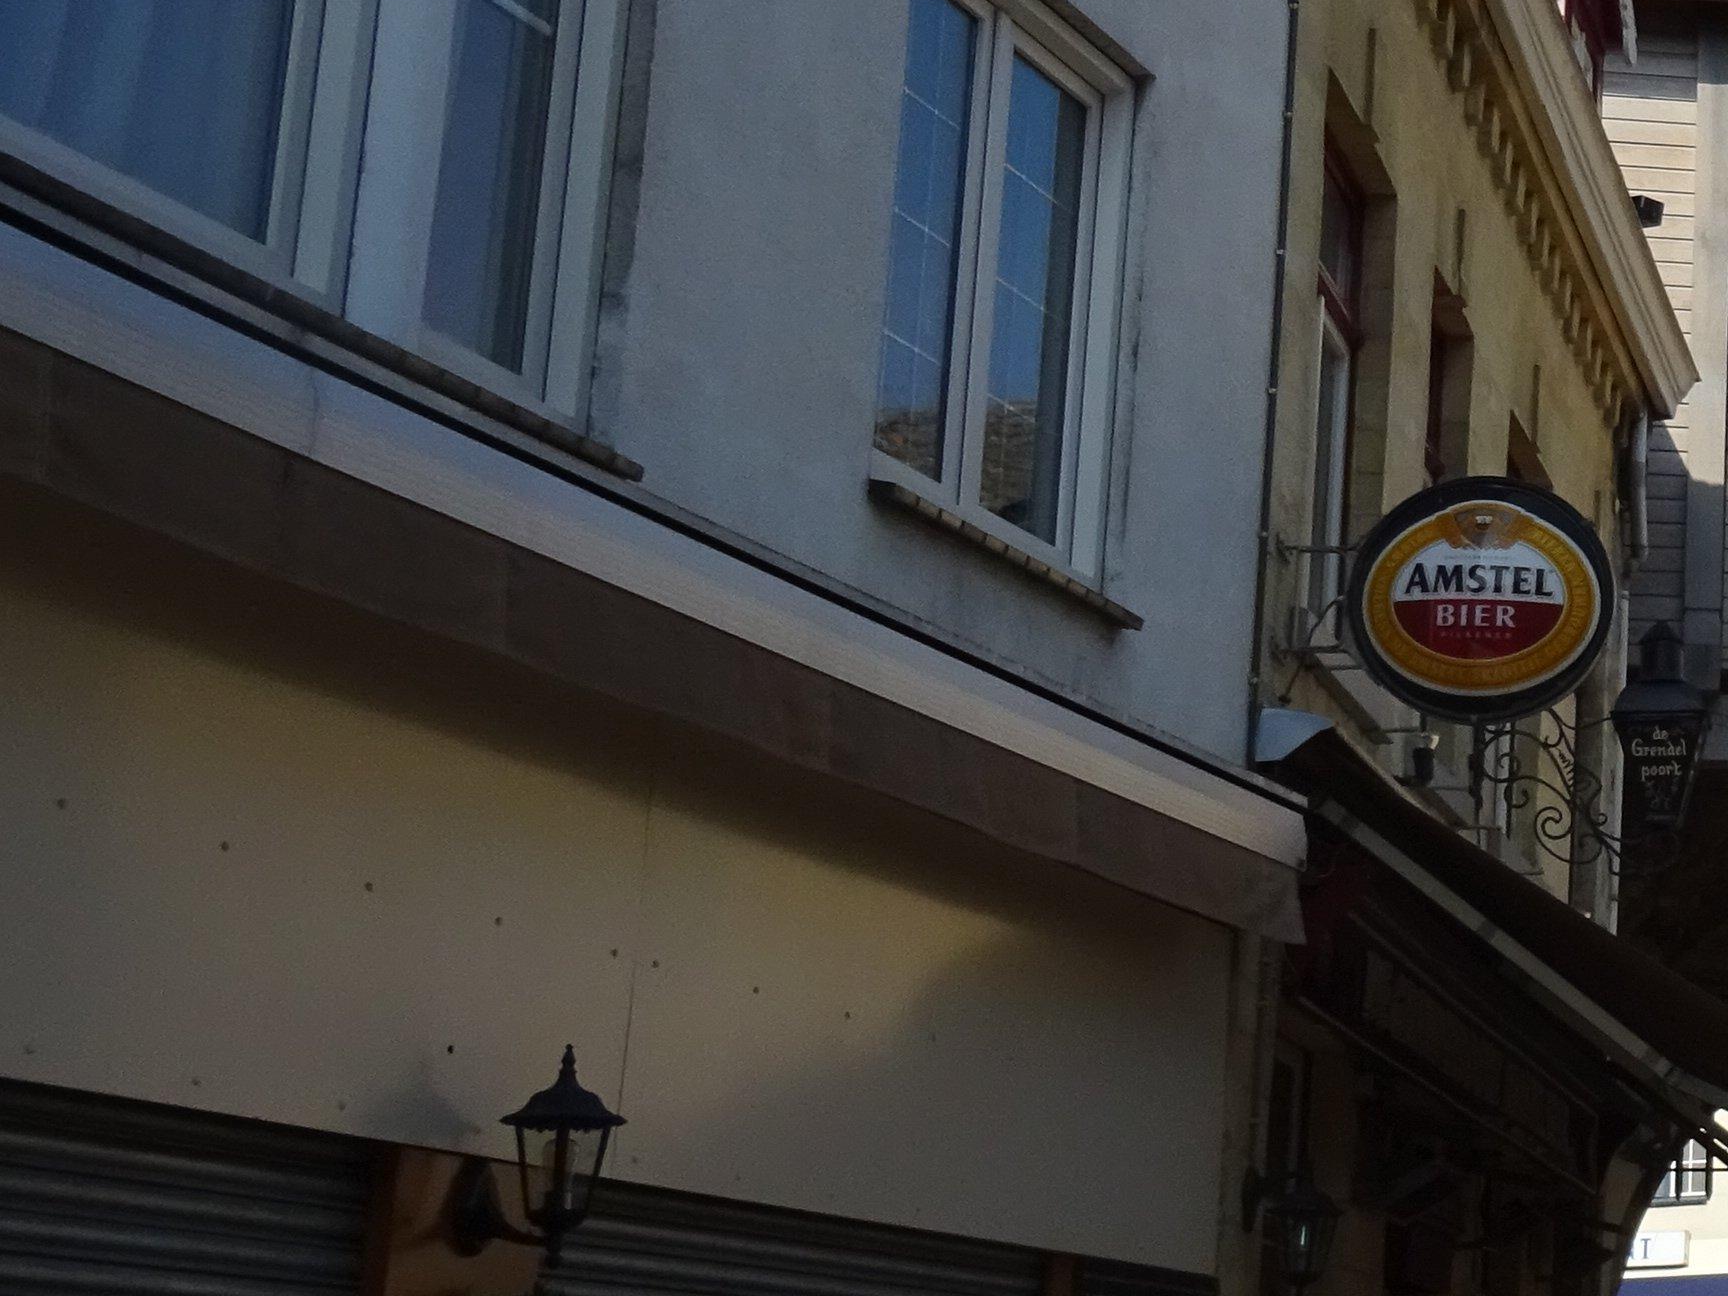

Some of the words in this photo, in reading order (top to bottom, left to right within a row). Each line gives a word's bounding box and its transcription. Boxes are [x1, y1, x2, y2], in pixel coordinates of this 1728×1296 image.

[1404, 562, 1554, 597] AMSTEL
[1436, 604, 1517, 629] BIER
[1630, 738, 1687, 757] Grendel
